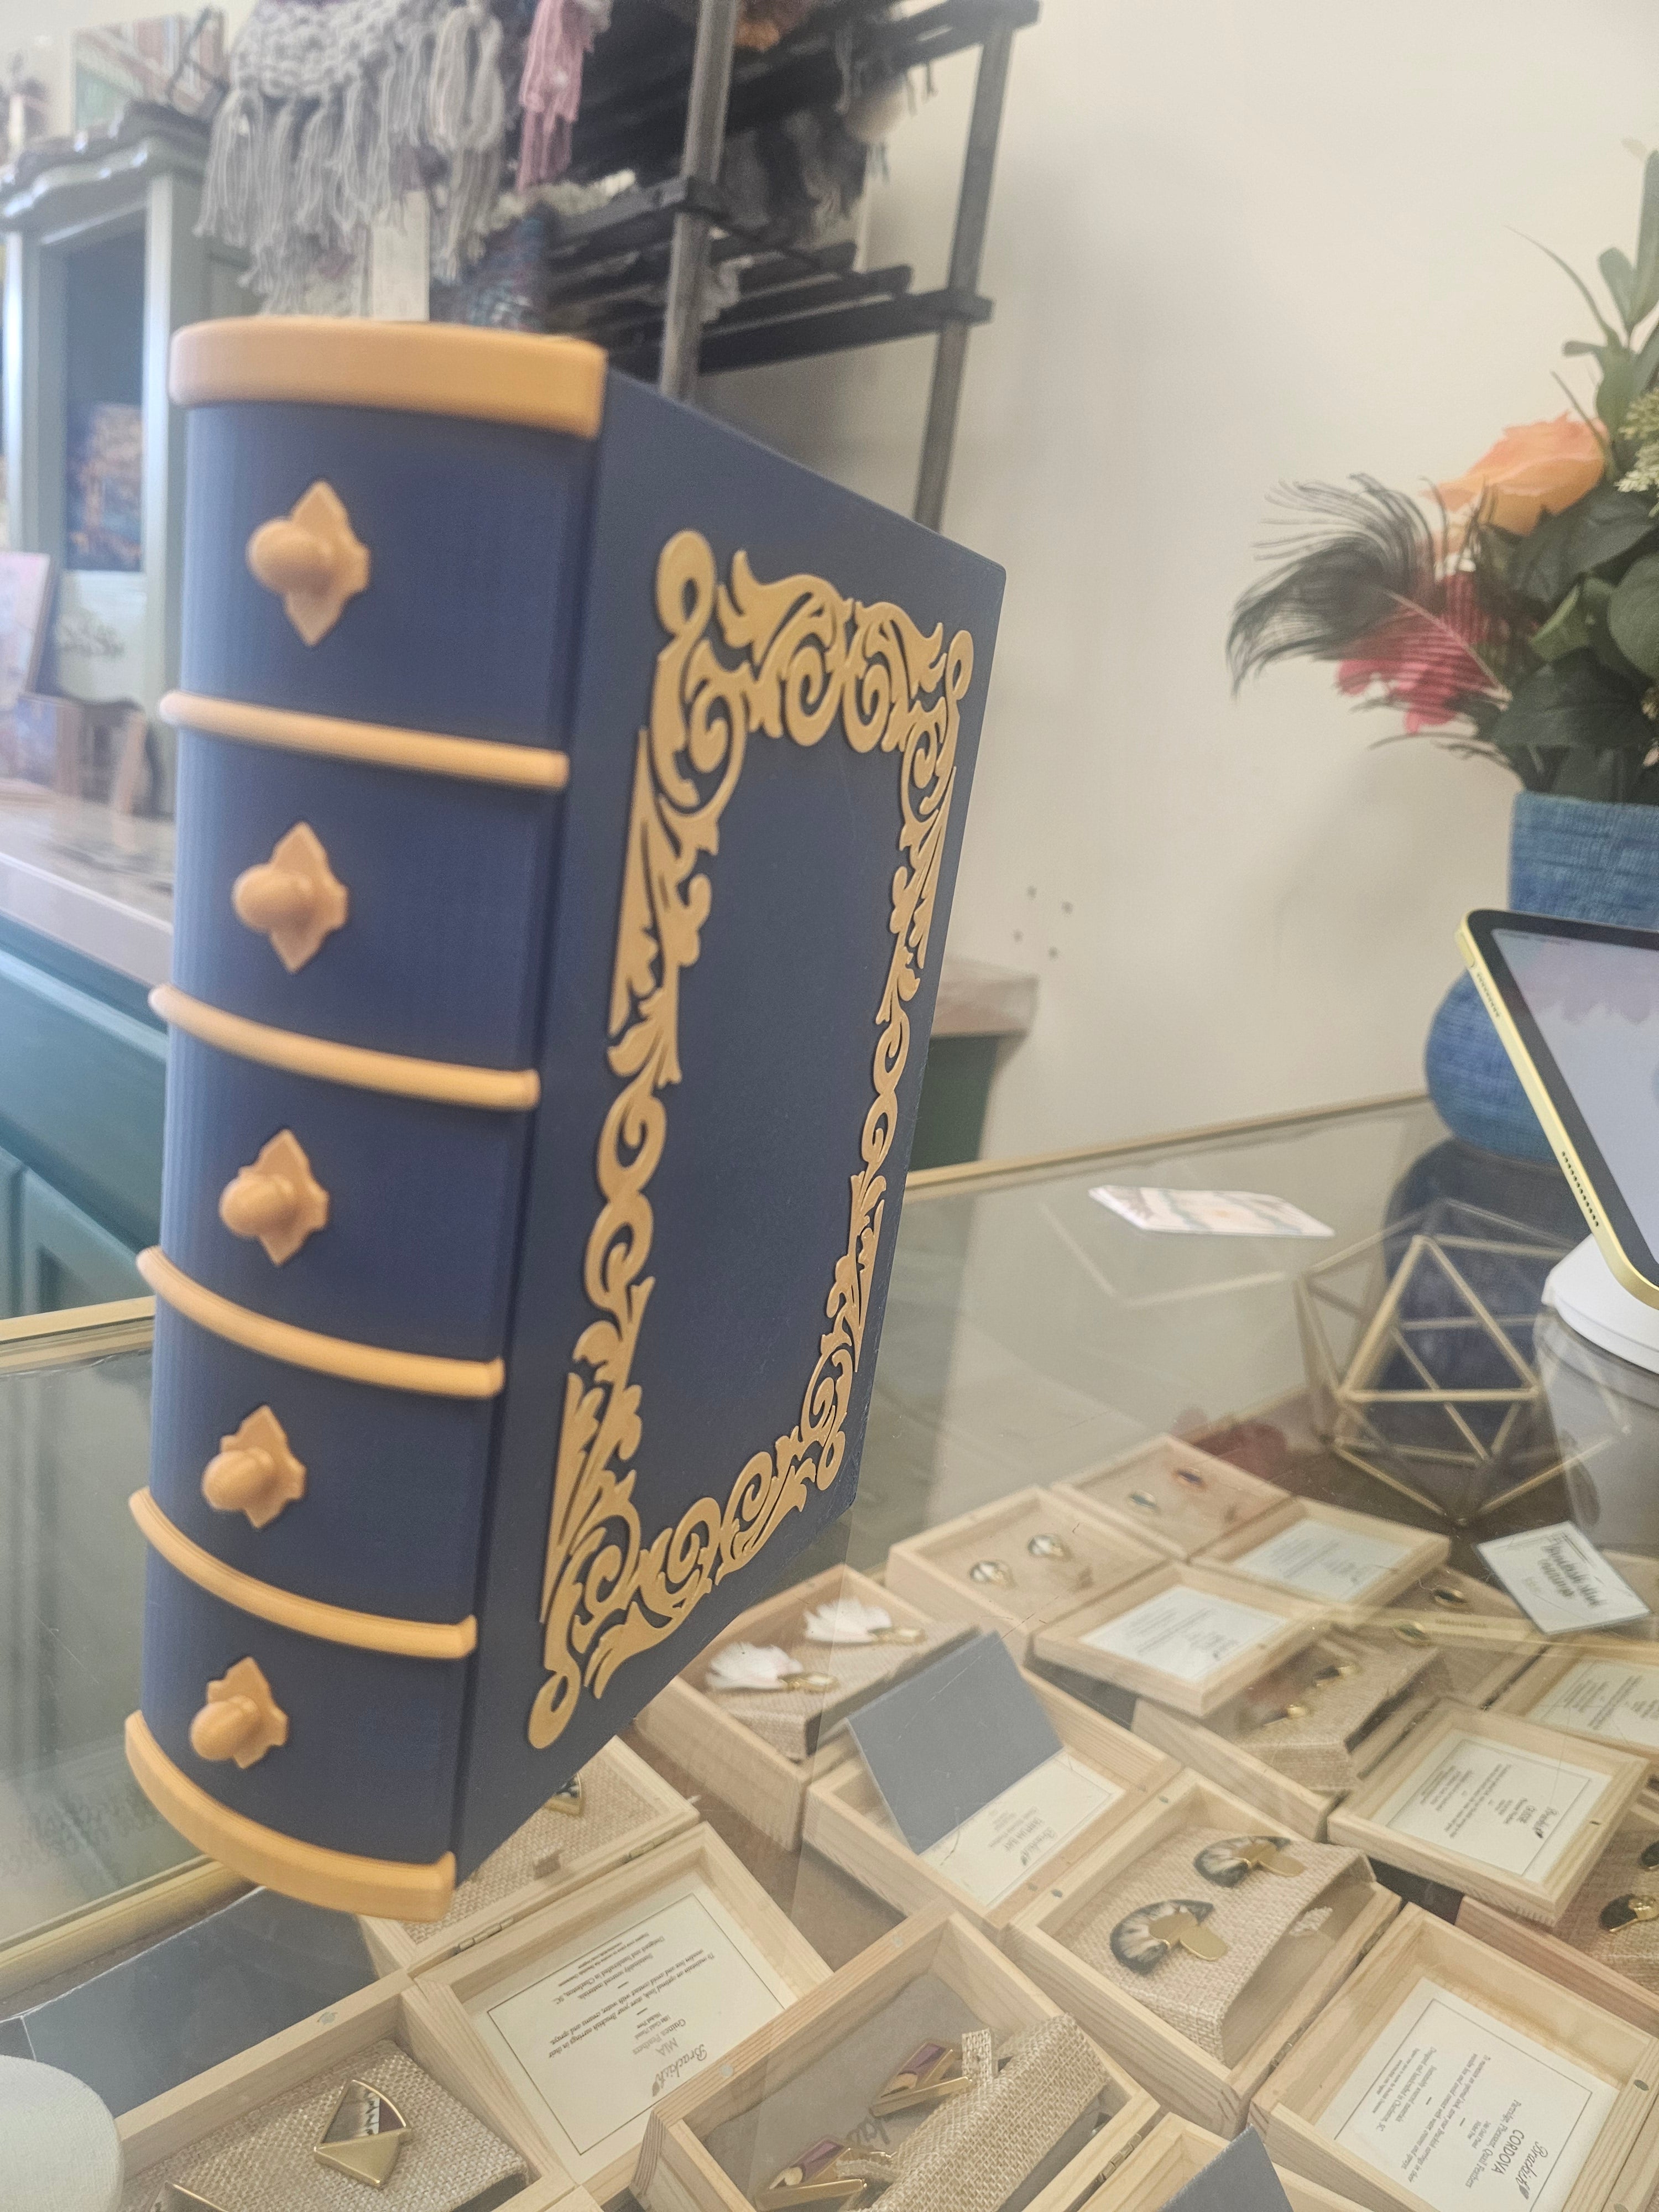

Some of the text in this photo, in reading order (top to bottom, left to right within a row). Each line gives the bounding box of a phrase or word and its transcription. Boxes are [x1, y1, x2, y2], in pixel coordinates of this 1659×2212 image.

[656, 1975, 676, 1992] optimal
[618, 1993, 631, 2005] with
[617, 2002, 630, 2015] your
[569, 2023, 581, 2035] and
[592, 2012, 617, 2031] Brackish
[569, 2027, 592, 2044] earrings
[632, 2018, 686, 2055] Guinea Feathers
[548, 2046, 562, 2058] their
[655, 2037, 679, 2057] MIA
[655, 2043, 707, 2089] Brackish
[1478, 2148, 1493, 2166] Quail
[1490, 2129, 1525, 2174] CORDOVA
[1515, 2141, 1548, 2190] Brackish
[1464, 2163, 1485, 2189] Feathers
